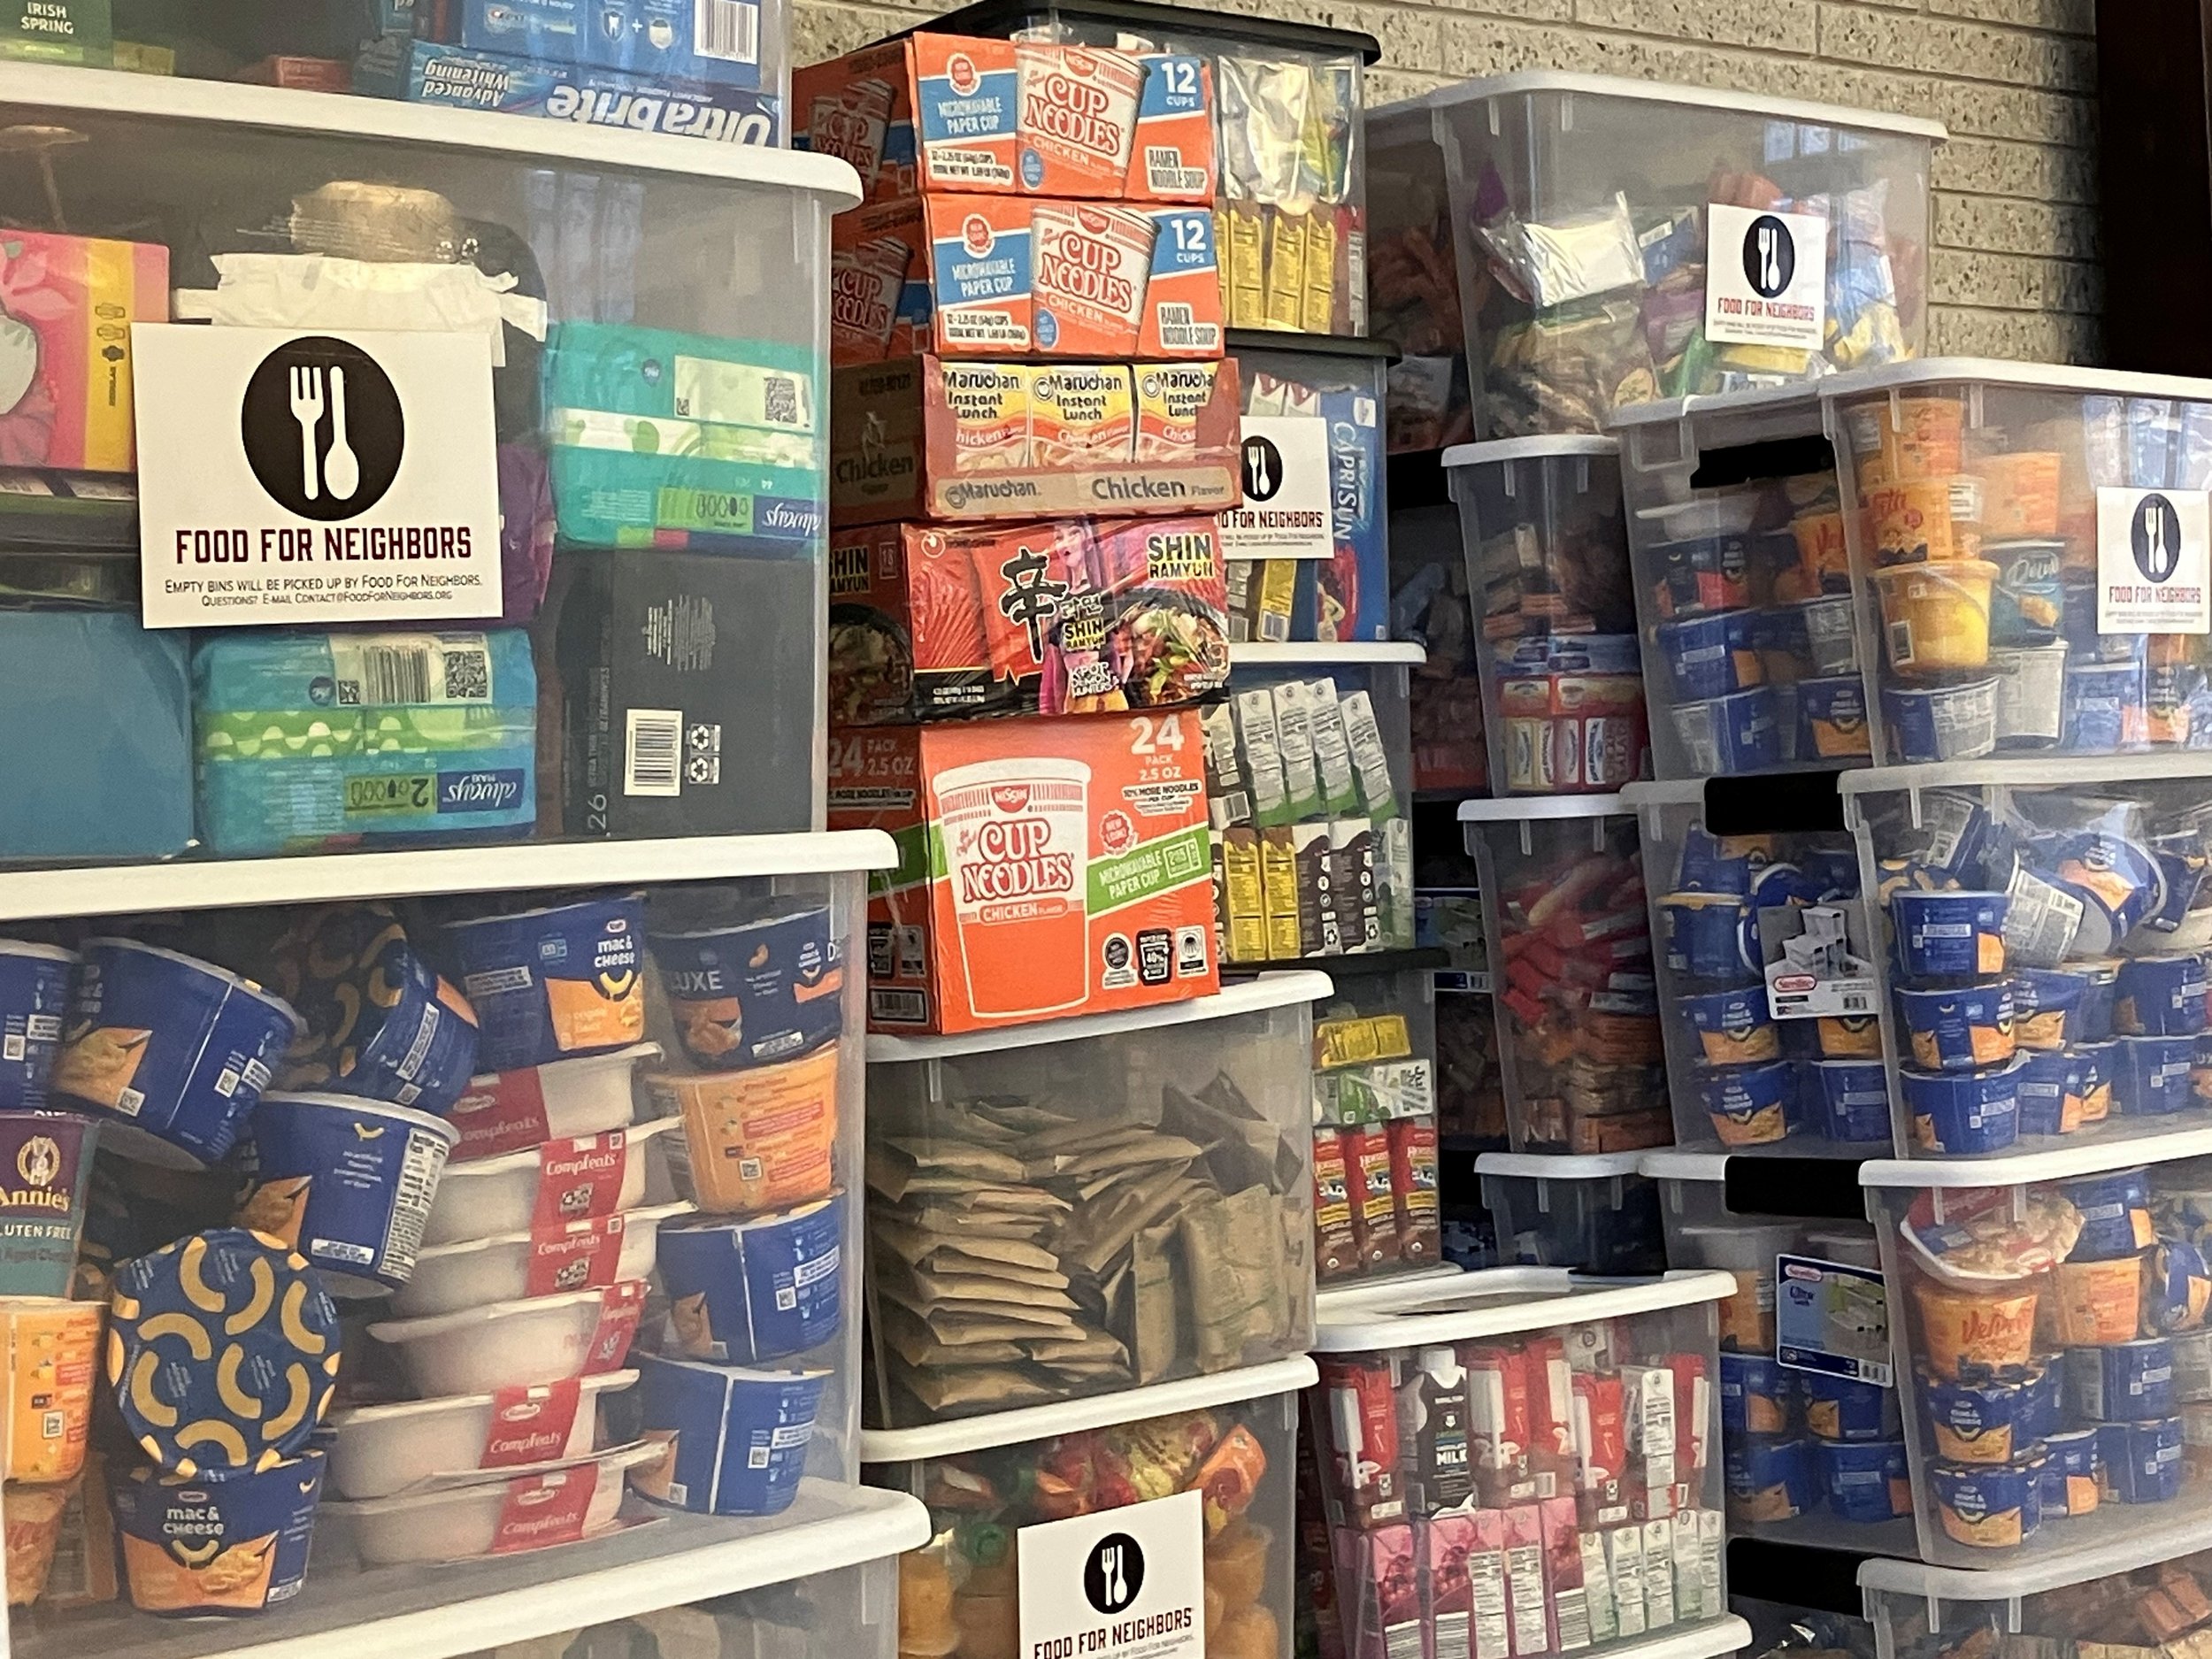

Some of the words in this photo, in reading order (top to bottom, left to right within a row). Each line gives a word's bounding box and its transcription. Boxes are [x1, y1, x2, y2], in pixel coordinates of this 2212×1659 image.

[27, 2, 66, 19] IRISH
[20, 16, 74, 35] SPRING
[424, 58, 510, 91] Whitening
[1161, 62, 1196, 94] 12
[421, 81, 505, 107] Advanced
[1046, 73, 1109, 118] CUP
[1166, 96, 1194, 107] CUPS
[947, 117, 979, 134] PAPER
[979, 115, 999, 131] CUP
[1025, 93, 1119, 156] NOODLES
[1033, 136, 1088, 165] CHICKEN
[1148, 150, 1179, 168] RAMEN
[1184, 171, 1204, 189] SOUP
[1171, 219, 1206, 250] 12
[1060, 231, 1121, 273] CUP
[1177, 252, 1205, 263] CUPS
[839, 269, 882, 302] CUP
[962, 280, 993, 297] PAPER
[995, 278, 1012, 292] CUP
[1040, 253, 1132, 312] NOODLES
[1048, 294, 1102, 322] CHICKEN
[1161, 307, 1190, 325] RAMEN
[1717, 297, 1741, 314] FOOD
[1746, 300, 1763, 316] FOR
[1164, 326, 1194, 345] NOODLE
[1195, 327, 1215, 345] SOUP
[943, 372, 1019, 389] Maruchan
[1049, 374, 1122, 390] Maruchan
[1156, 373, 1213, 388] Marucha
[949, 392, 1002, 406] Instant
[1057, 394, 1107, 407] Instant
[1164, 391, 1205, 404] Instant
[956, 407, 997, 419] Lunch
[1064, 408, 1102, 420] Lunch
[1169, 405, 1196, 417] Lunc
[956, 428, 1000, 445] hicken
[1164, 426, 1195, 442] Chick
[837, 453, 913, 483] Chicken
[959, 480, 1036, 499] Maruchan
[1092, 476, 1186, 500] Chicken
[763, 503, 822, 537] always
[1233, 511, 1255, 528] FOR
[1259, 511, 1323, 527] NEIGHBORS
[176, 530, 248, 564] FOOD
[260, 529, 313, 562] FOR
[324, 527, 472, 560] NEIGHBORS
[1148, 535, 1210, 562] SHIN
[830, 548, 868, 575] HIN
[1149, 562, 1213, 578] RAMYUN
[208, 580, 234, 592] BINS
[237, 580, 263, 591] WILL
[266, 579, 280, 590] BE
[284, 578, 323, 590] PICKED
[326, 578, 341, 589] UP
[345, 578, 358, 588] BY
[362, 575, 393, 588] FOOD
[396, 574, 418, 587] FOR
[2109, 587, 2131, 603] FOOD
[2135, 587, 2152, 603] FOR
[1001, 547, 1068, 664] 辛
[1064, 619, 1102, 640] SHIN
[1071, 662, 1109, 679] KPOP
[1130, 714, 1185, 754] 24
[867, 740, 896, 753] PACK
[829, 737, 864, 777] 24
[868, 758, 888, 775] 2.5
[892, 757, 914, 775] OZ
[1146, 754, 1172, 765] PACK
[1140, 768, 1158, 781] 2.5
[1162, 766, 1182, 779] OZ
[411, 779, 429, 807] 2
[448, 775, 517, 806] always
[994, 787, 1027, 803] NISSIN
[1139, 787, 1161, 795] MORE
[1163, 783, 1198, 794] NOODLES
[588, 794, 607, 829] 26
[979, 818, 1051, 863] CUP
[962, 853, 1073, 902] NOODLES
[1099, 849, 1162, 887] MICROWAVABLE
[1110, 876, 1141, 900] PAPER
[1141, 869, 1161, 887] CUP
[983, 902, 1038, 922] CHICKEN
[598, 938, 625, 953] mac
[462, 1117, 541, 1141] ompleats
[547, 1152, 617, 1175] Compleats
[0, 1224, 42, 1239] UTEN
[46, 1226, 72, 1240] FREE
[490, 1432, 561, 1454] Compleats
[1437, 1449, 1467, 1465] MILK
[166, 1509, 205, 1520] mac
[207, 1506, 219, 1521] &
[1035, 1637, 1072, 1659] FOOD
[1079, 1629, 1106, 1654] FOR
[1113, 1607, 1192, 1646] NEIGHBORS
